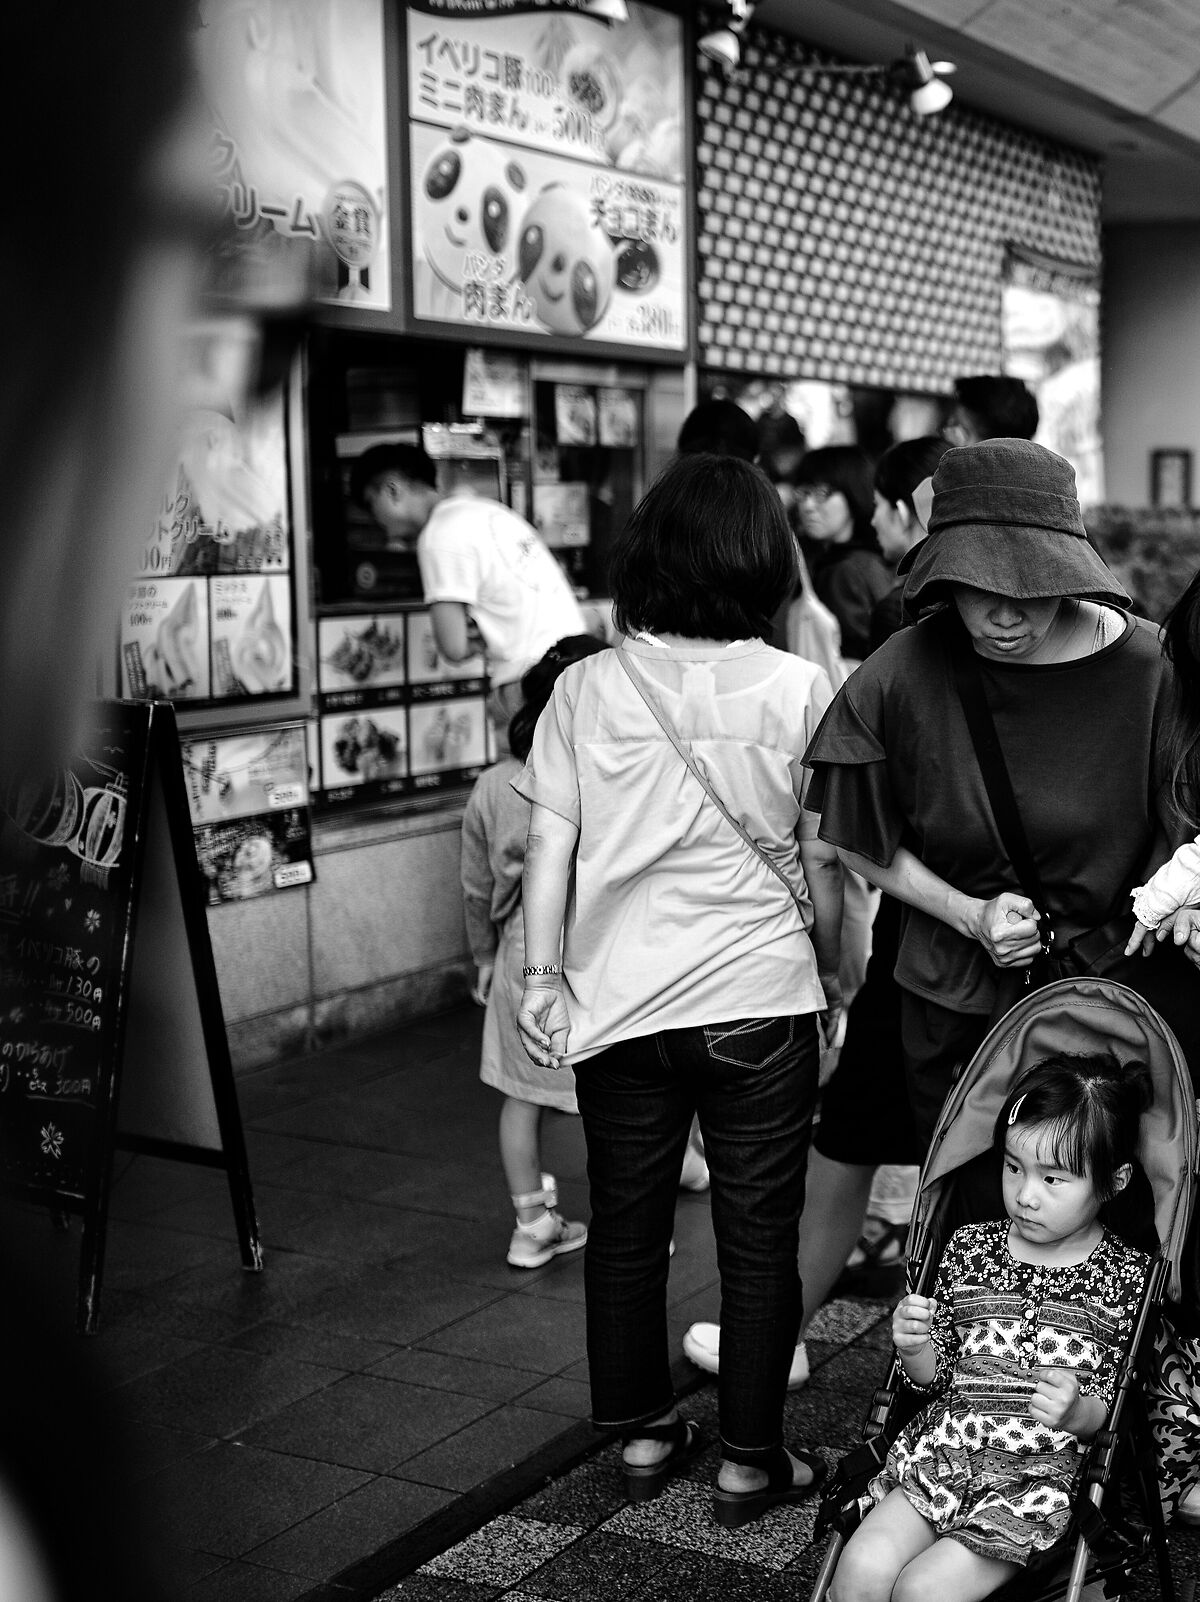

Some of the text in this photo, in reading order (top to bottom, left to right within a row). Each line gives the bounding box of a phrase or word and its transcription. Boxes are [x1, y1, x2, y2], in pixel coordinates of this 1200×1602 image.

[419, 70, 529, 131] ミニ肉まん
[463, 280, 536, 322] 肉まん
